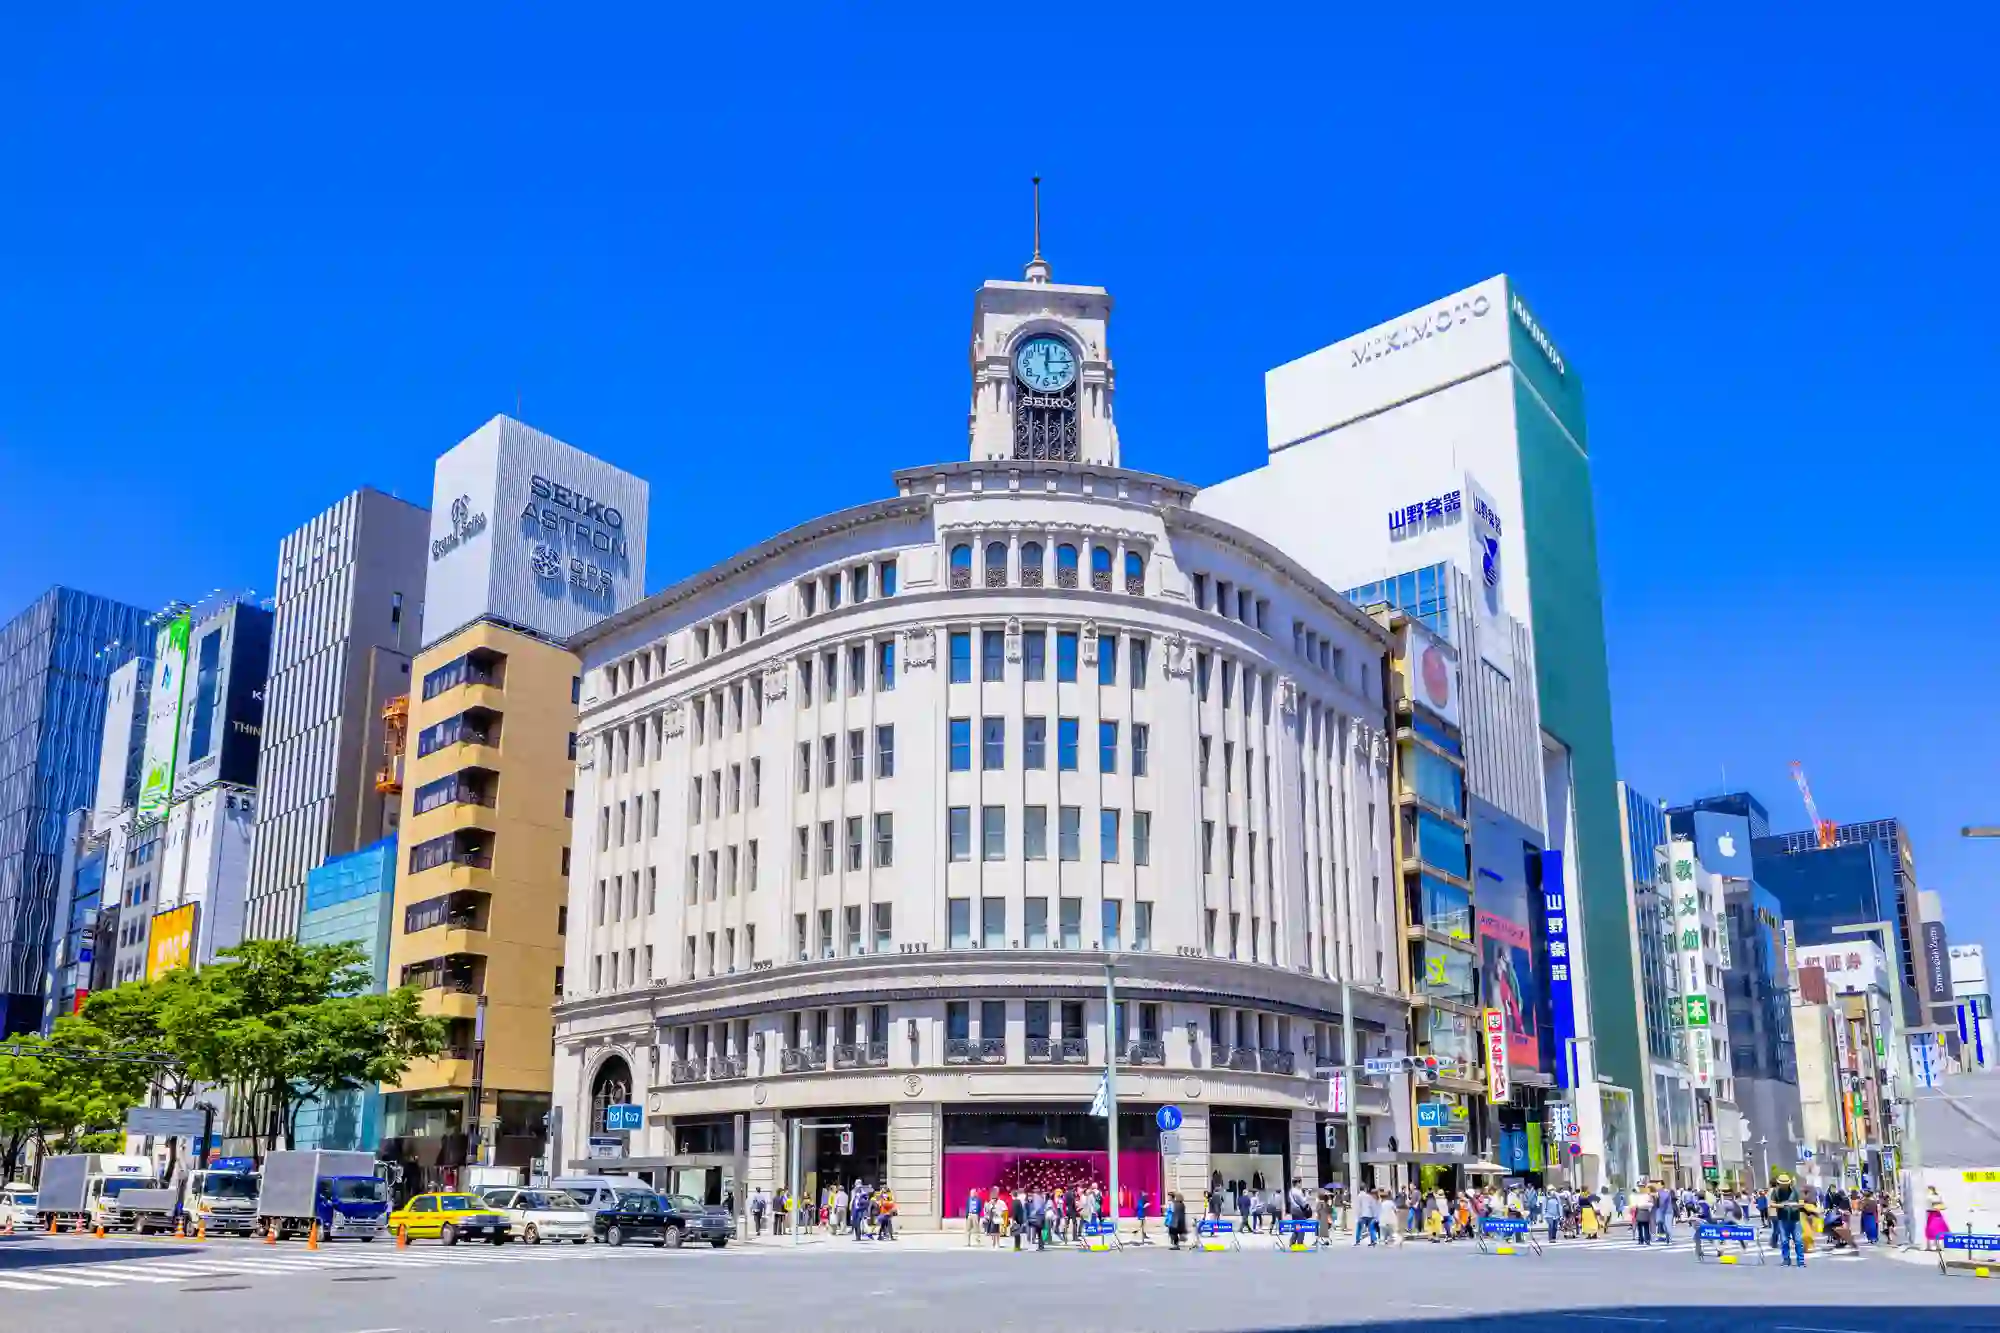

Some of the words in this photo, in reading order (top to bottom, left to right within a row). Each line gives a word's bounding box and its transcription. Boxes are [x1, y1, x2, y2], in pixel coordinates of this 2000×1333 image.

[1023, 396, 1072, 408] SEIKO
[529, 475, 623, 529] SEIKO
[1388, 489, 1461, 530] 山野楽器
[520, 502, 628, 559] ASTRON
[1546, 893, 1568, 981] 山野楽器
[1687, 999, 1706, 1022] 本
